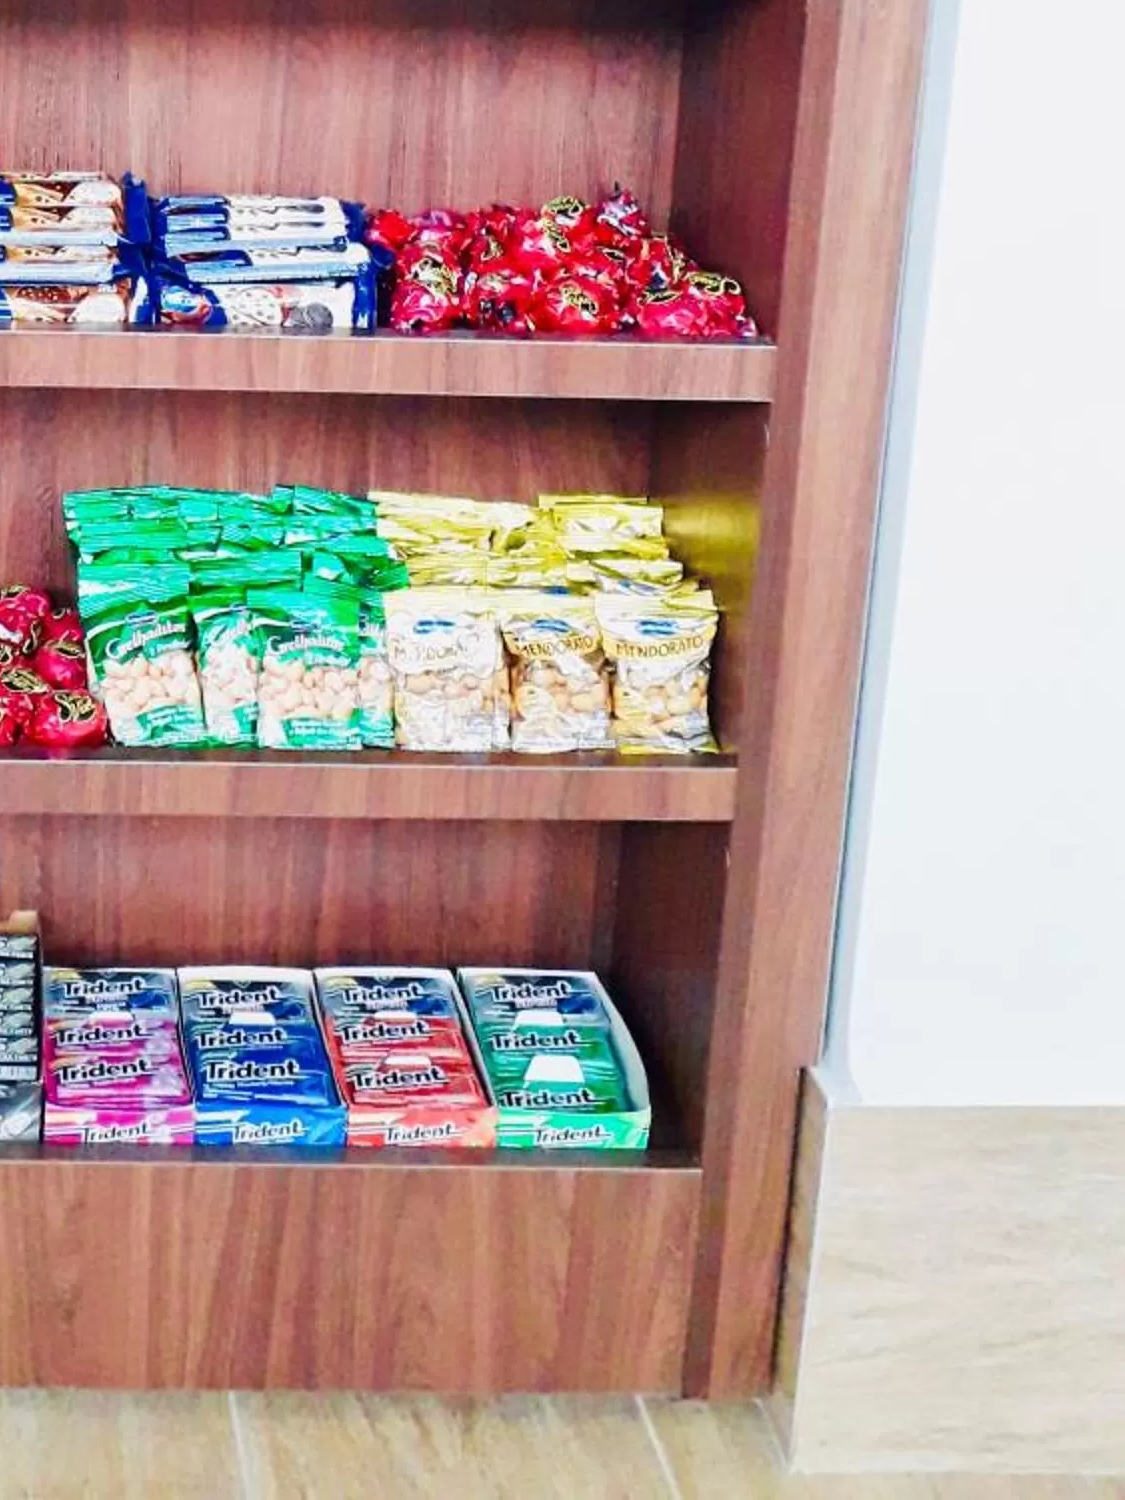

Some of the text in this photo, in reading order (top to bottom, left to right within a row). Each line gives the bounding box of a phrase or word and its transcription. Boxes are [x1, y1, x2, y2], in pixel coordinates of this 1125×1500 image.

[62, 977, 146, 997] Trident
[199, 986, 281, 1007] Trident
[342, 983, 424, 1003] Trident
[491, 980, 571, 1002] Trident
[56, 1023, 144, 1044] Trident
[197, 1028, 287, 1048] Trident
[341, 1021, 430, 1042] Trident
[491, 1030, 580, 1050] Trident
[58, 1059, 150, 1083] Trident
[207, 1059, 299, 1081] Trident
[352, 1067, 446, 1088] Trident
[501, 1089, 594, 1108] Trident
[83, 1123, 148, 1142] Trident
[233, 1119, 303, 1141] Trident
[386, 1122, 454, 1142] Trident
[536, 1126, 603, 1143] Trident
